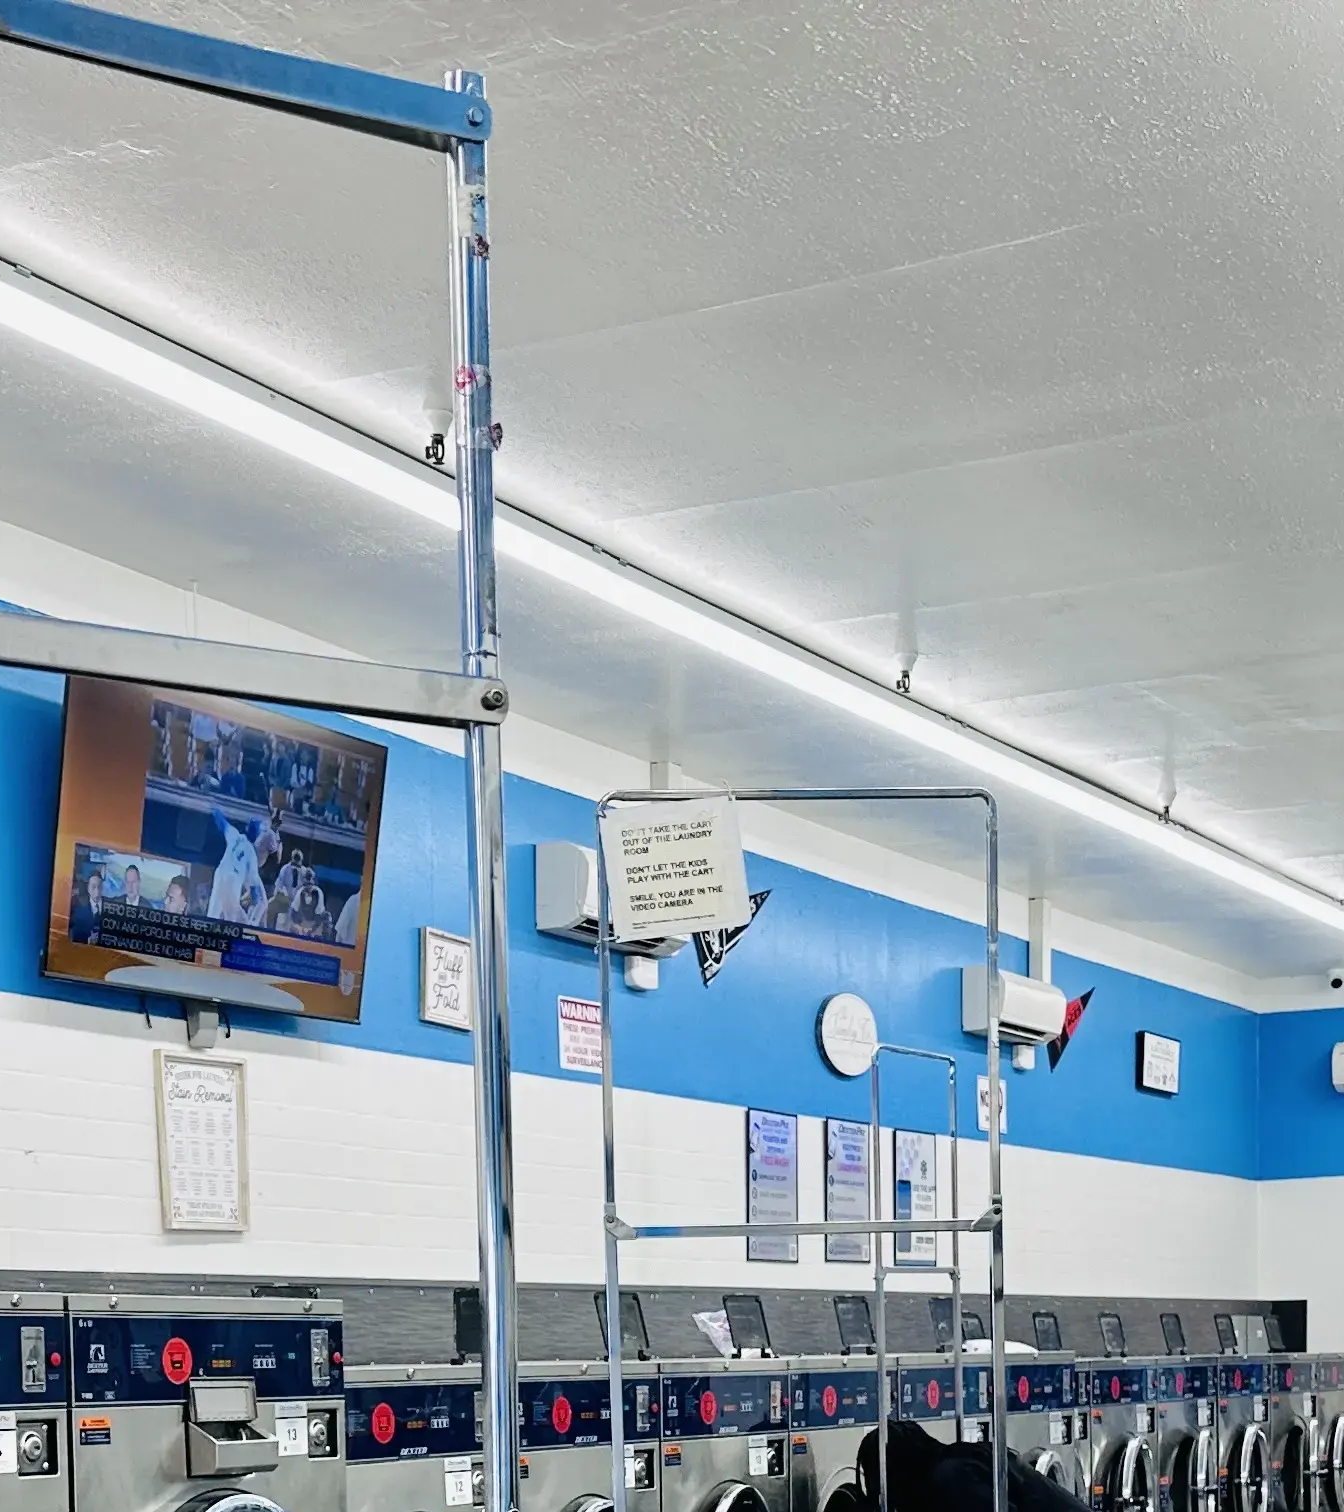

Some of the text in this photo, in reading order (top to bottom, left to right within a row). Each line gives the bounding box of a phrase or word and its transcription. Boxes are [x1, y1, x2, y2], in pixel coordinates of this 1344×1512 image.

[672, 823, 687, 832] THE
[690, 820, 712, 830] CART
[623, 830, 712, 847] OUT OF THE LAUNDRY
[624, 847, 649, 856] ROOM
[653, 863, 668, 872] LET
[670, 861, 686, 869] THE
[689, 859, 708, 868] KIDS
[627, 868, 714, 884] PLAY WITH THE CART
[659, 890, 676, 899] YOU
[678, 888, 696, 897] ARE
[697, 887, 706, 895] IN
[707, 885, 723, 894] THE
[630, 898, 694, 912] VIDEO CAMERA
[126, 907, 136, 918] ES
[433, 945, 463, 980] Fluff
[432, 983, 459, 1011] Fold
[561, 1002, 601, 1022] WARNIN
[566, 1056, 603, 1068] SURVEILLANC
[287, 1428, 297, 1441] 13
